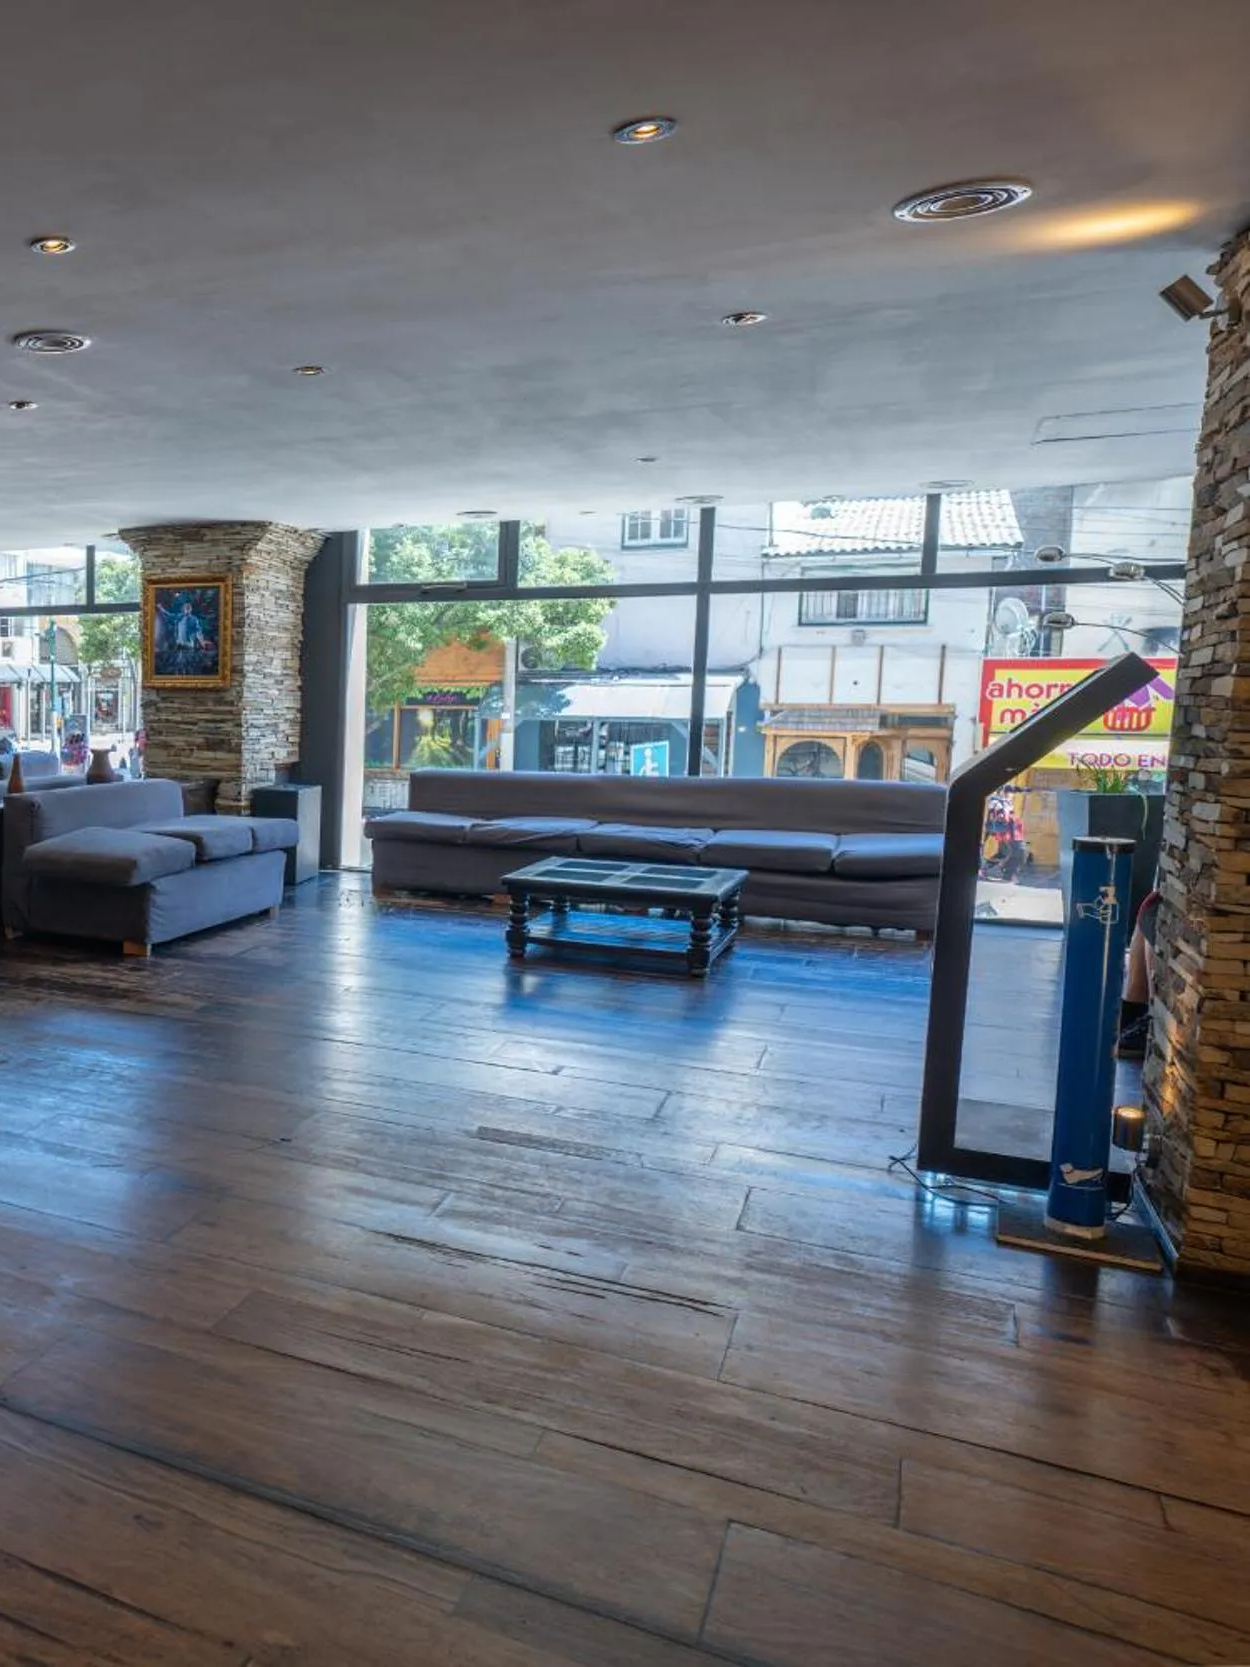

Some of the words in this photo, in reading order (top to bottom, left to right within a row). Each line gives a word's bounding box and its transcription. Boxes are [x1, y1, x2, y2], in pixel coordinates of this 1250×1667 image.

[988, 677, 1073, 699] ahorr
[1068, 752, 1131, 768] TODO
[1137, 754, 1166, 768] EN
